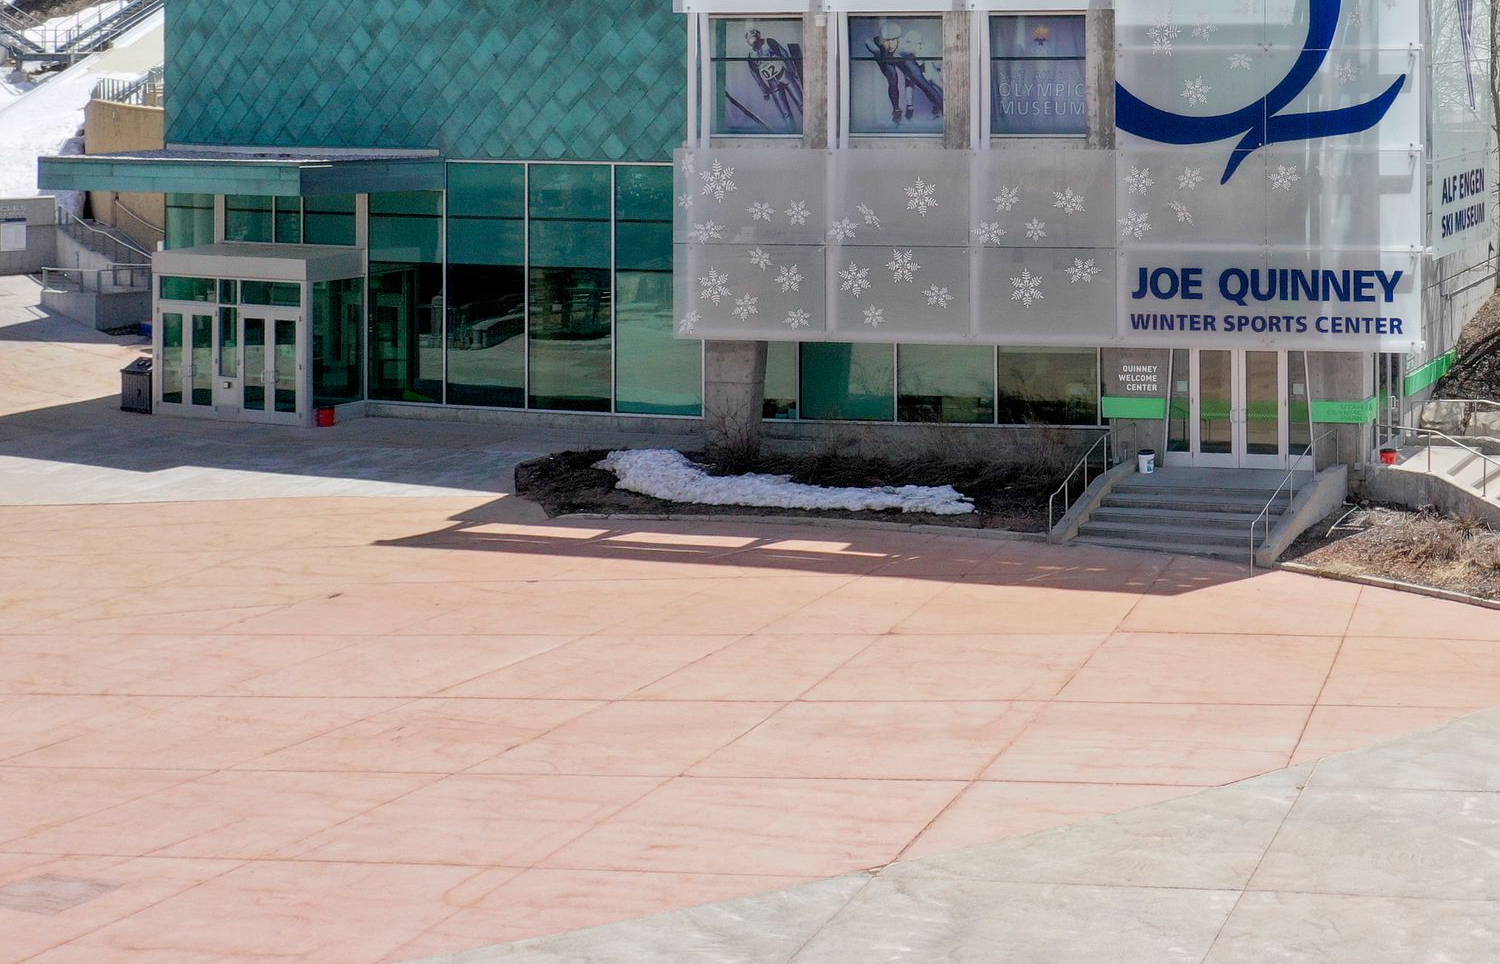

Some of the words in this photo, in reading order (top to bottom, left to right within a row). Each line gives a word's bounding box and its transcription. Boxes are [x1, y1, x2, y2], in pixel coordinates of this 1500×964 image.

[761, 64, 779, 78] 02
[998, 82, 1085, 97] OLYMPIC
[1000, 101, 1086, 115] MUSEUM
[1441, 175, 1457, 205] ALF
[1459, 167, 1485, 200] ENGEN
[1441, 212, 1454, 239] SKI
[1455, 201, 1485, 235] MUSEUM
[1131, 266, 1204, 301] JOE
[1218, 267, 1404, 307] QUINNEY
[1130, 313, 1217, 332] WINTER
[1223, 314, 1308, 334] SPORTS
[1315, 316, 1404, 336] CENTER
[1122, 365, 1158, 373] QUINNEY
[1118, 374, 1158, 382] WELCOME
[1126, 383, 1158, 391] CENTER
